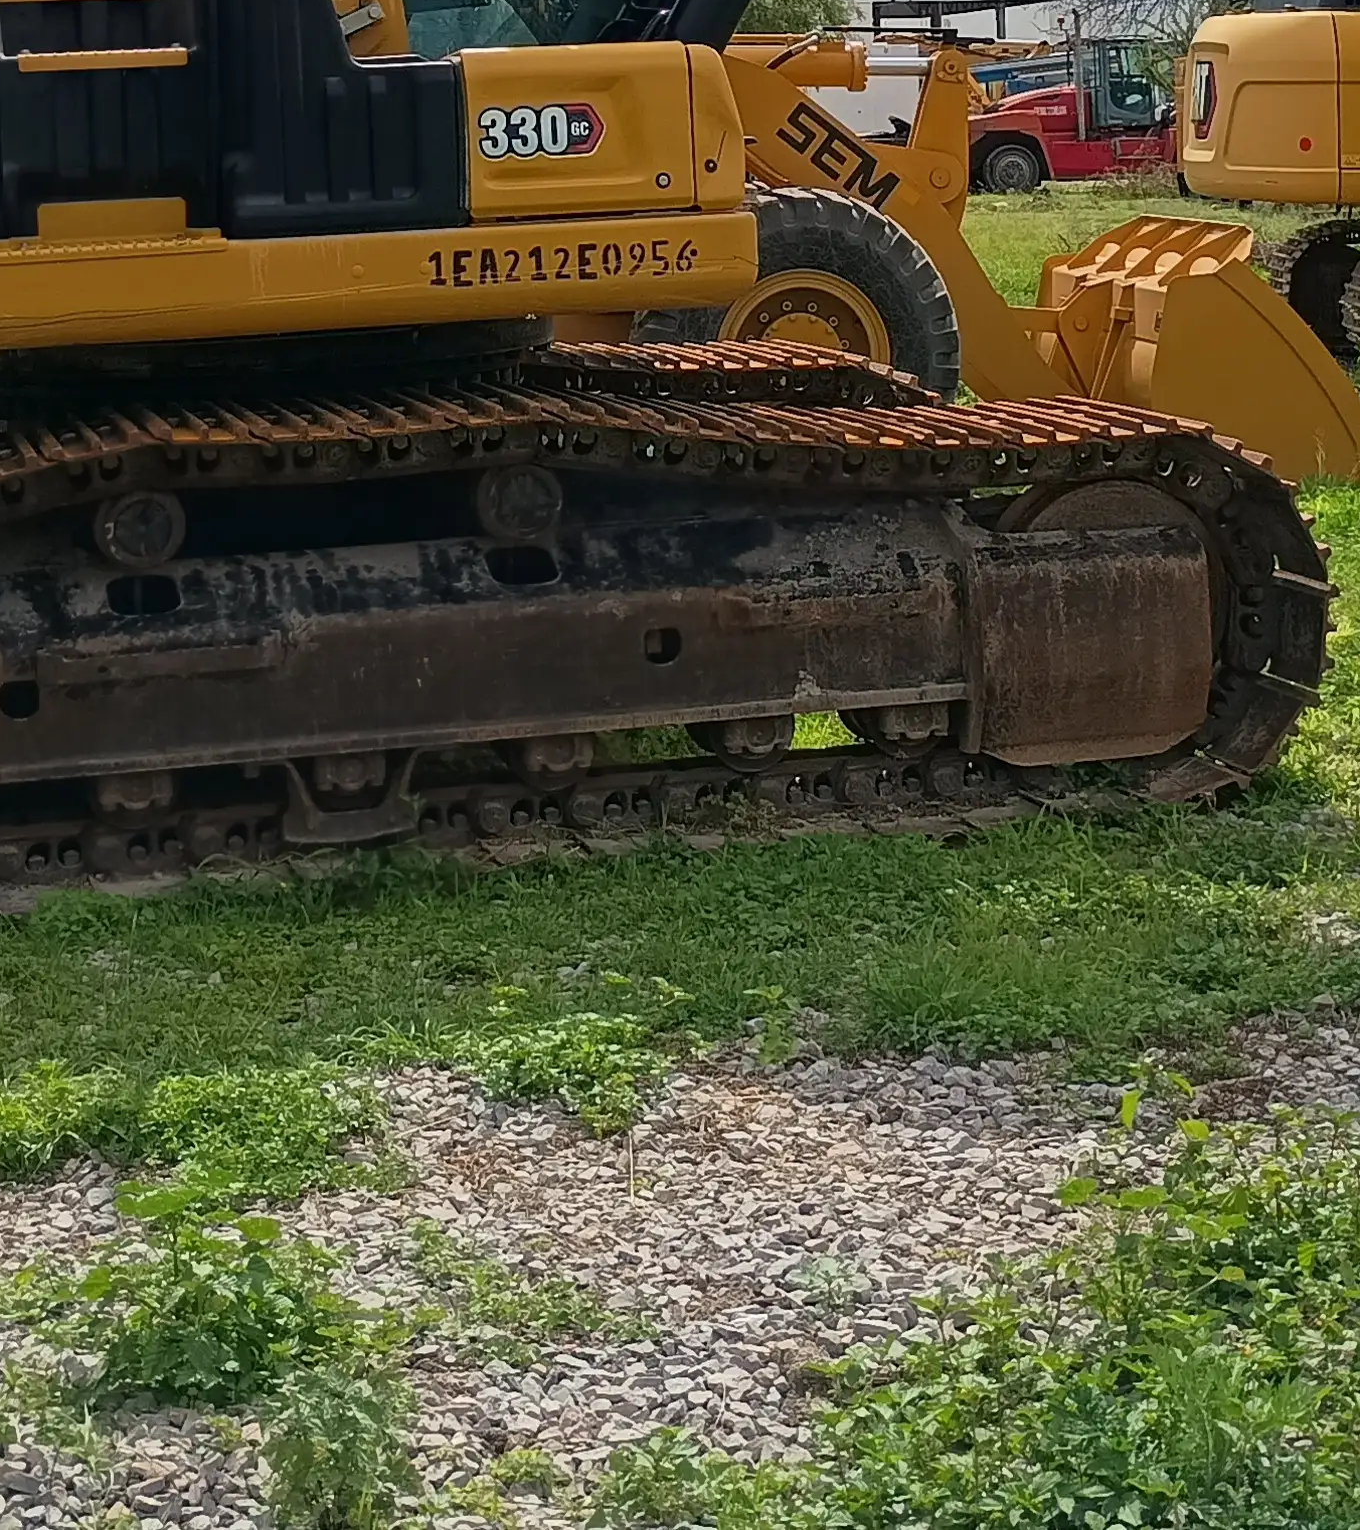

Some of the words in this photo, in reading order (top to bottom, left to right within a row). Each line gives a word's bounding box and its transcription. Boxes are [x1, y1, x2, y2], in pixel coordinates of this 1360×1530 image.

[479, 106, 568, 158] 330
[570, 121, 590, 137] GC
[776, 101, 901, 210] SEM
